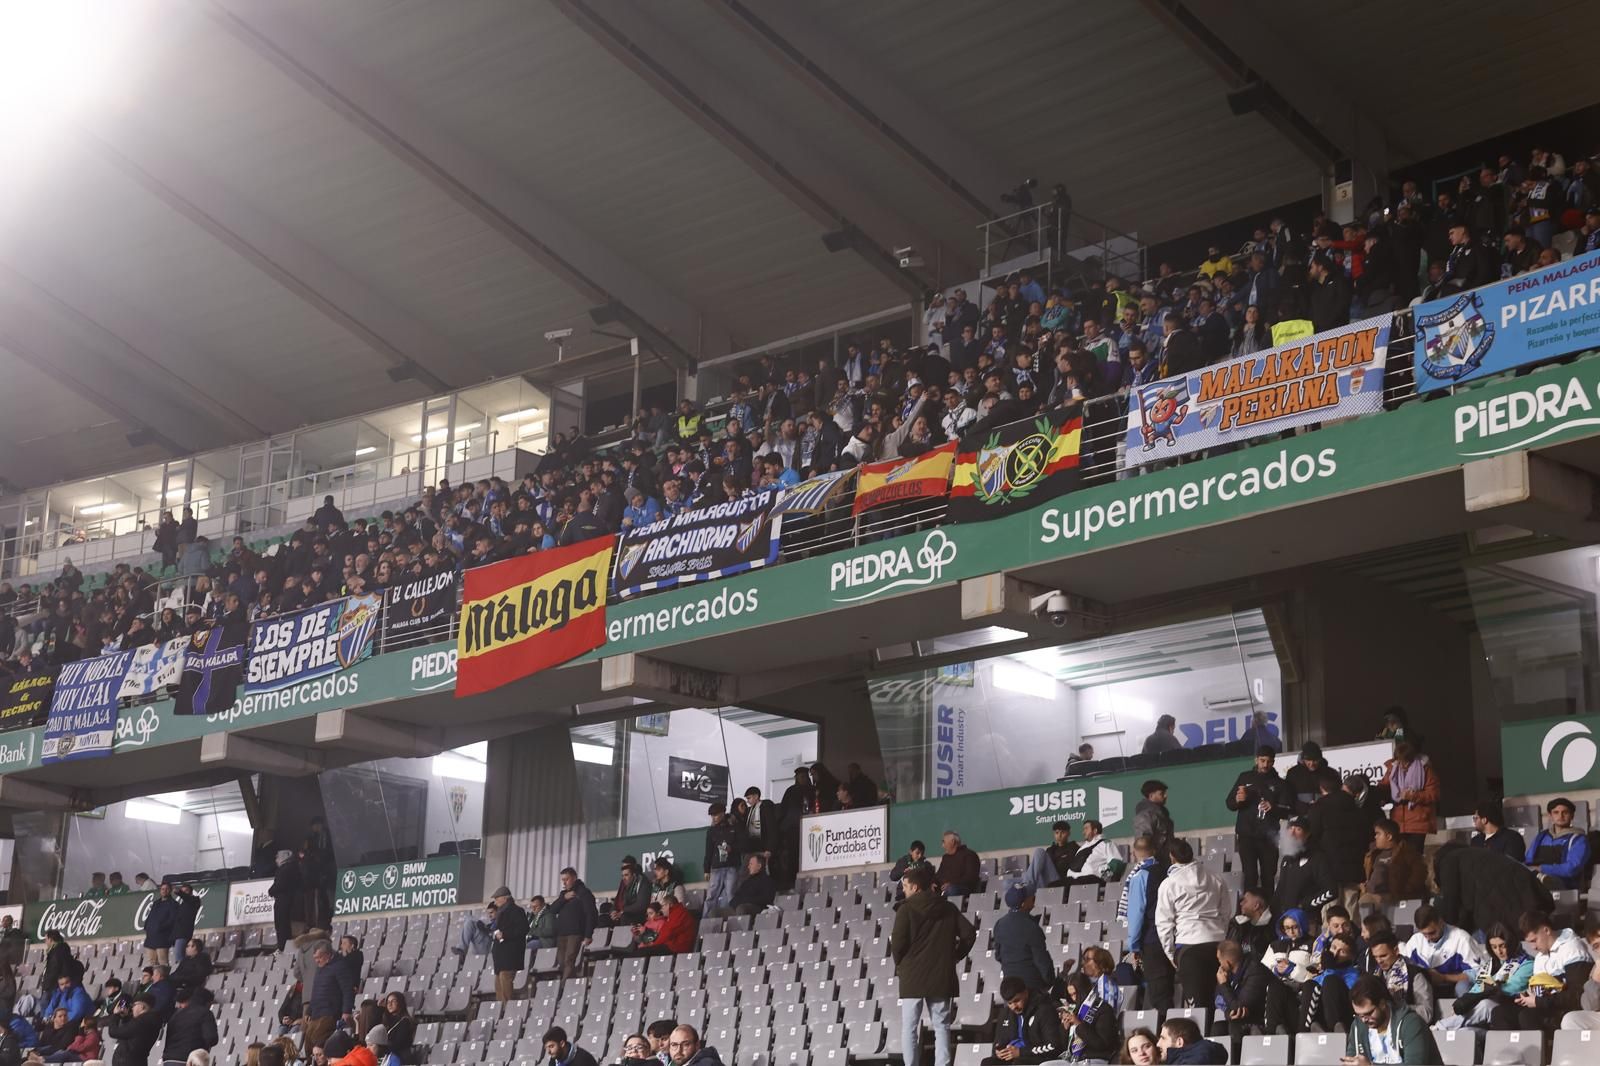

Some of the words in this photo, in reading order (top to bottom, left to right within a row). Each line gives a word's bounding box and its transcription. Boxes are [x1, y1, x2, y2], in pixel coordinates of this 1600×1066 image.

[1507, 277, 1540, 295] PEÑA
[1196, 326, 1379, 403] MALAKATON
[1219, 372, 1340, 431] PERIANA
[1040, 448, 1337, 543] Supermercados
[642, 523, 738, 563] ARCHIDONA
[391, 585, 402, 604] EL
[465, 569, 598, 653] Málaga
[606, 586, 759, 642] ermercados
[253, 620, 295, 653] LOS
[297, 607, 331, 643] DE
[247, 632, 341, 684] SIEMPRE
[77, 681, 112, 710] LEAL
[956, 708, 967, 752] Industry
[956, 753, 964, 787] Smart
[1009, 789, 1087, 815] DEUSER
[1035, 813, 1056, 824] Smart
[1057, 811, 1086, 823] Industry
[825, 825, 881, 842] Fundación
[825, 841, 867, 855] Córdoba
[868, 837, 882, 850] CF
[401, 872, 454, 888] MOTORRAD
[403, 862, 427, 875] BMW
[244, 902, 273, 915] Córdoba
[335, 897, 360, 915] SAN
[362, 892, 409, 912] RAFAEL
[411, 887, 457, 906] MOTOR
